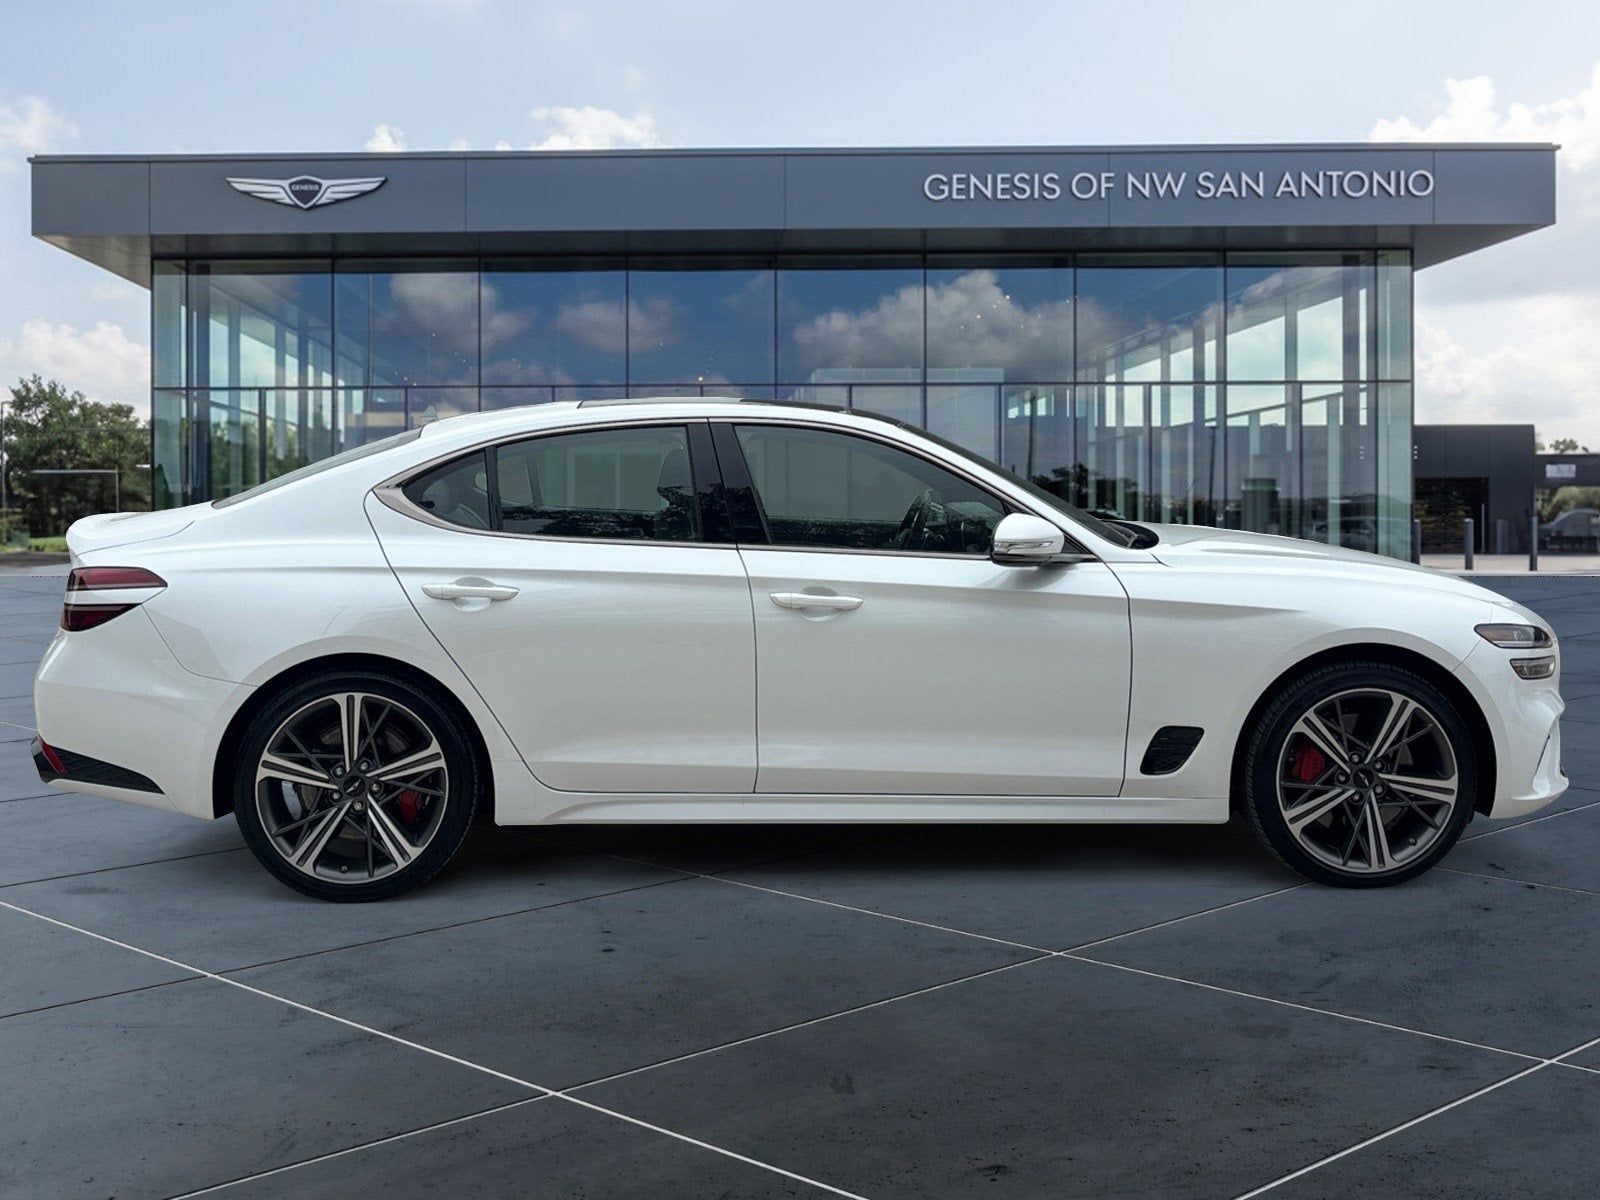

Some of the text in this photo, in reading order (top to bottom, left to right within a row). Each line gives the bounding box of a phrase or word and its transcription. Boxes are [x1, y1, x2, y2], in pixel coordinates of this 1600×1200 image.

[922, 169, 1435, 201] GENESIS OF NW SAN ANTONIO
